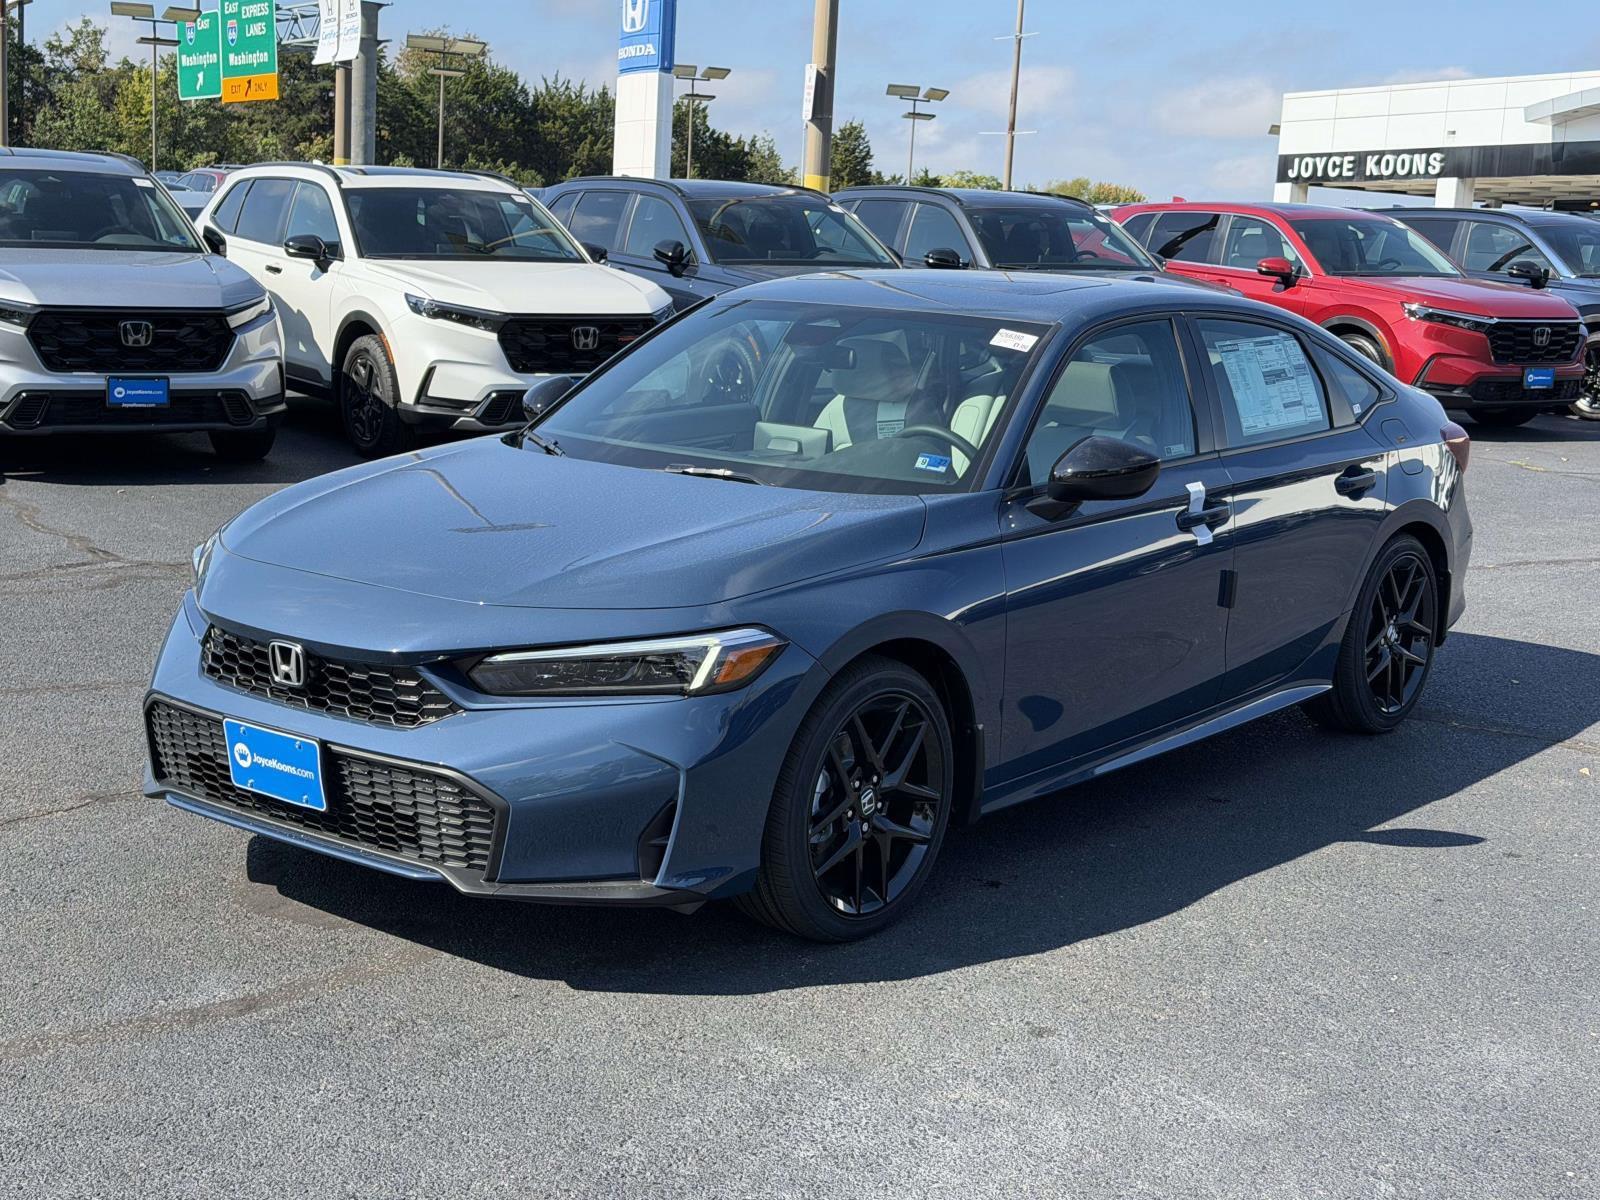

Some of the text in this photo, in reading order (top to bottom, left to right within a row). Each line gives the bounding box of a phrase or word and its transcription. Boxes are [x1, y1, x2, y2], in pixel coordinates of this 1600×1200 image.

[224, 2, 239, 15] EAST
[241, 2, 269, 19] EXPRESS
[197, 18, 210, 30] EAST
[245, 22, 266, 37] LANES
[181, 51, 217, 68] Washington
[229, 50, 269, 68] Washington
[618, 43, 656, 60] HONDA
[231, 82, 268, 94] EXIT ONLY
[1288, 153, 1445, 178] JOYCE KOONS
[253, 752, 315, 780] JoyceKoons.com
